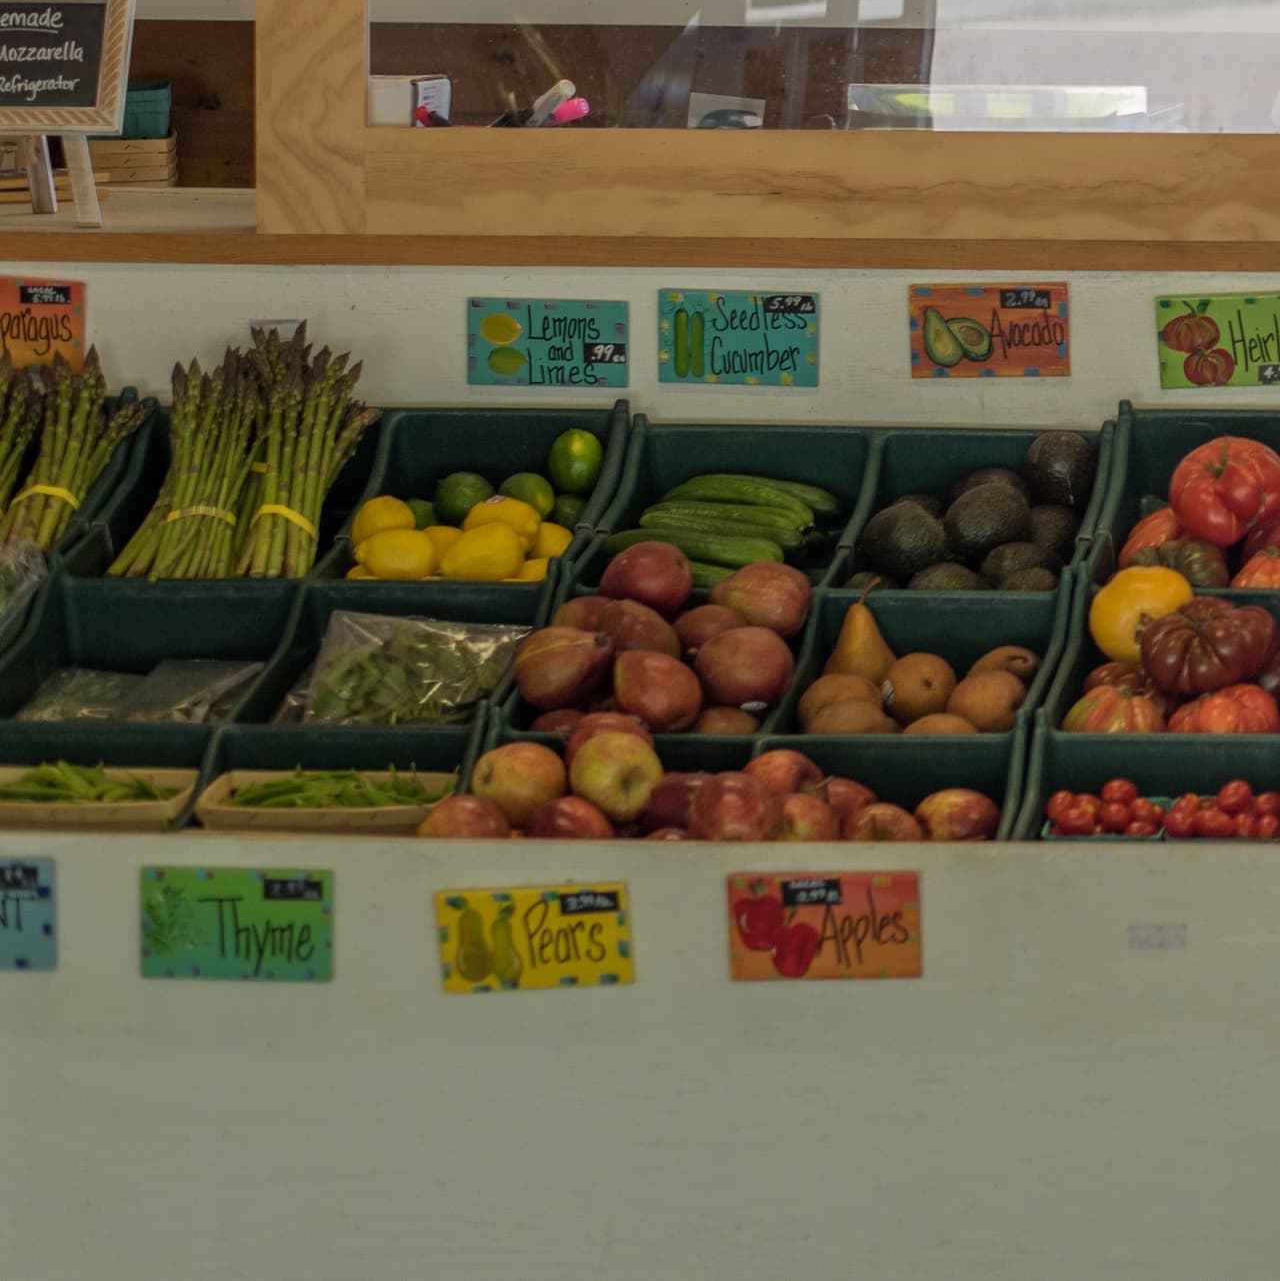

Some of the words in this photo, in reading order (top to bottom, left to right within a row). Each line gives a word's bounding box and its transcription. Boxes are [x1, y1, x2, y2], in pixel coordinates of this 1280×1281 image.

[526, 304, 601, 342] Lemons
[711, 296, 808, 332] Seedless
[769, 296, 802, 310] 5.99
[548, 340, 574, 361] and
[989, 307, 1064, 360] Avocado
[526, 347, 600, 385] Limes
[710, 332, 800, 377] Cucumber
[197, 897, 315, 977] Thyme
[522, 898, 606, 969] Pears
[816, 886, 909, 969] Apples
